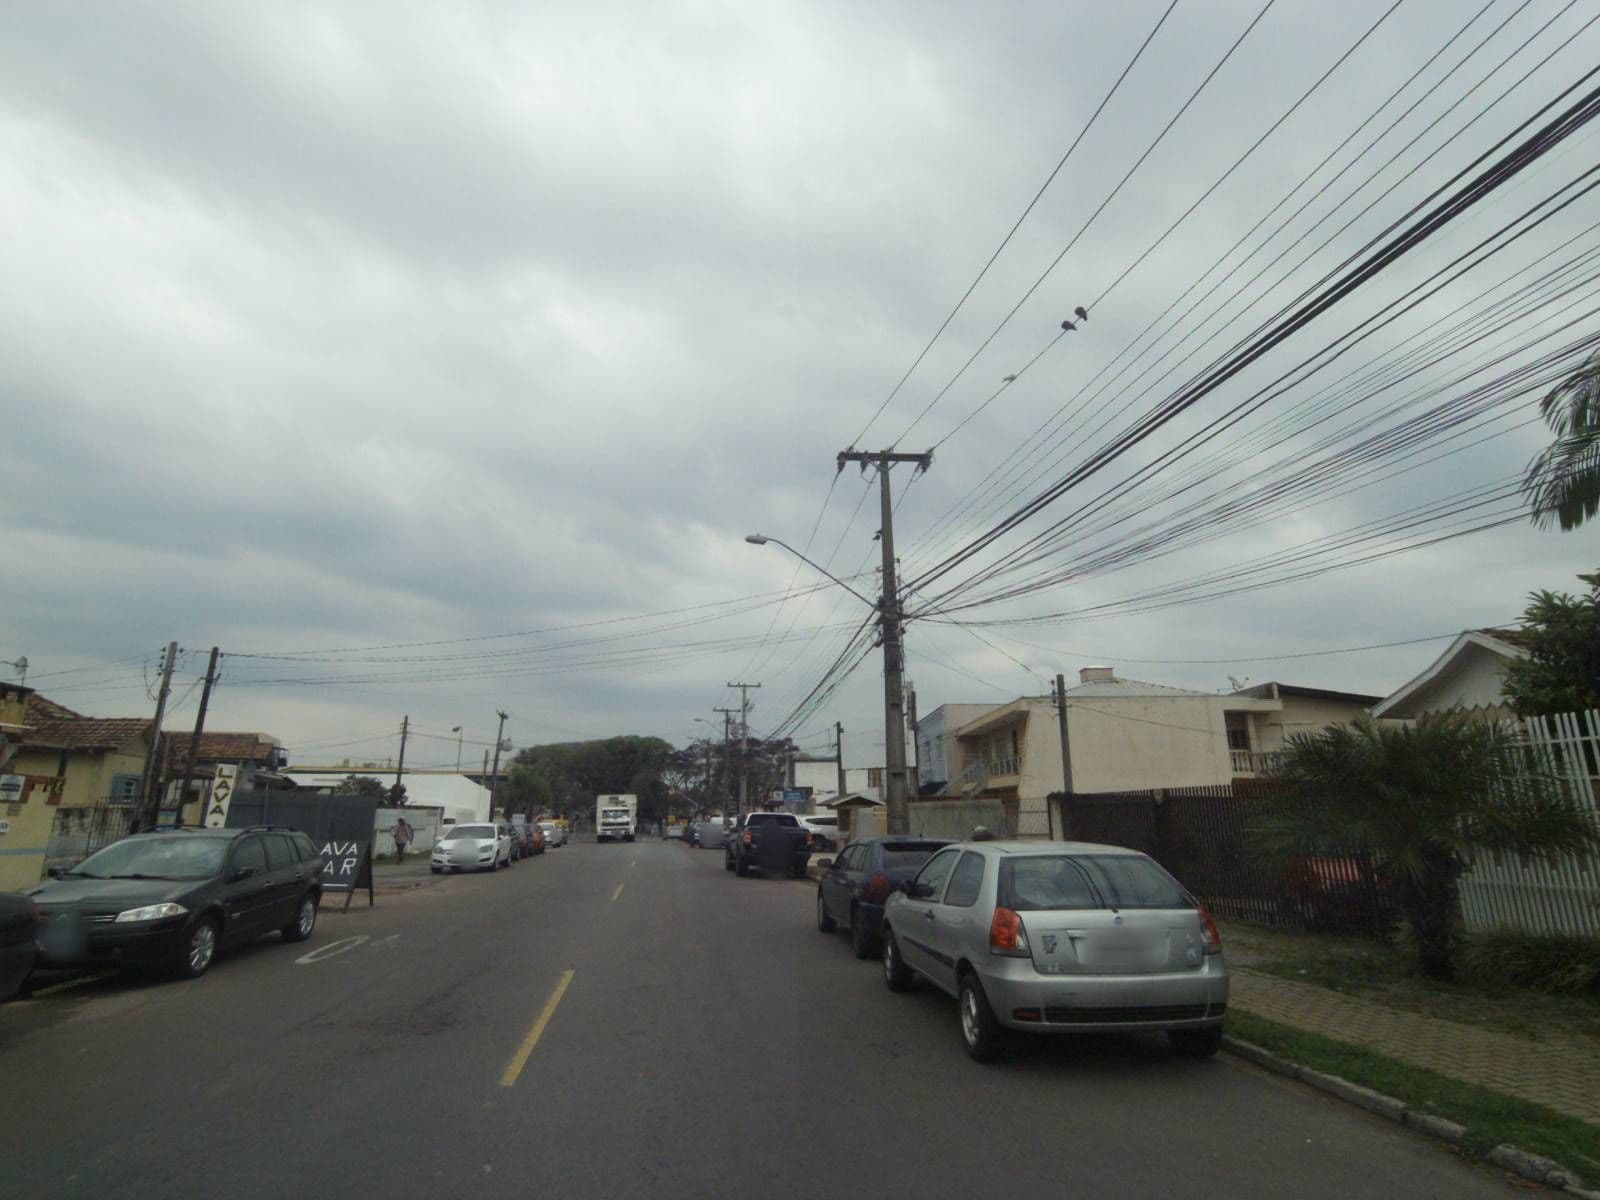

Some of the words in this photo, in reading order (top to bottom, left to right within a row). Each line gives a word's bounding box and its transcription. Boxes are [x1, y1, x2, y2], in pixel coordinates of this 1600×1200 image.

[208, 767, 233, 816] LAVA
[319, 841, 358, 856] AVA
[322, 858, 357, 875] AR
